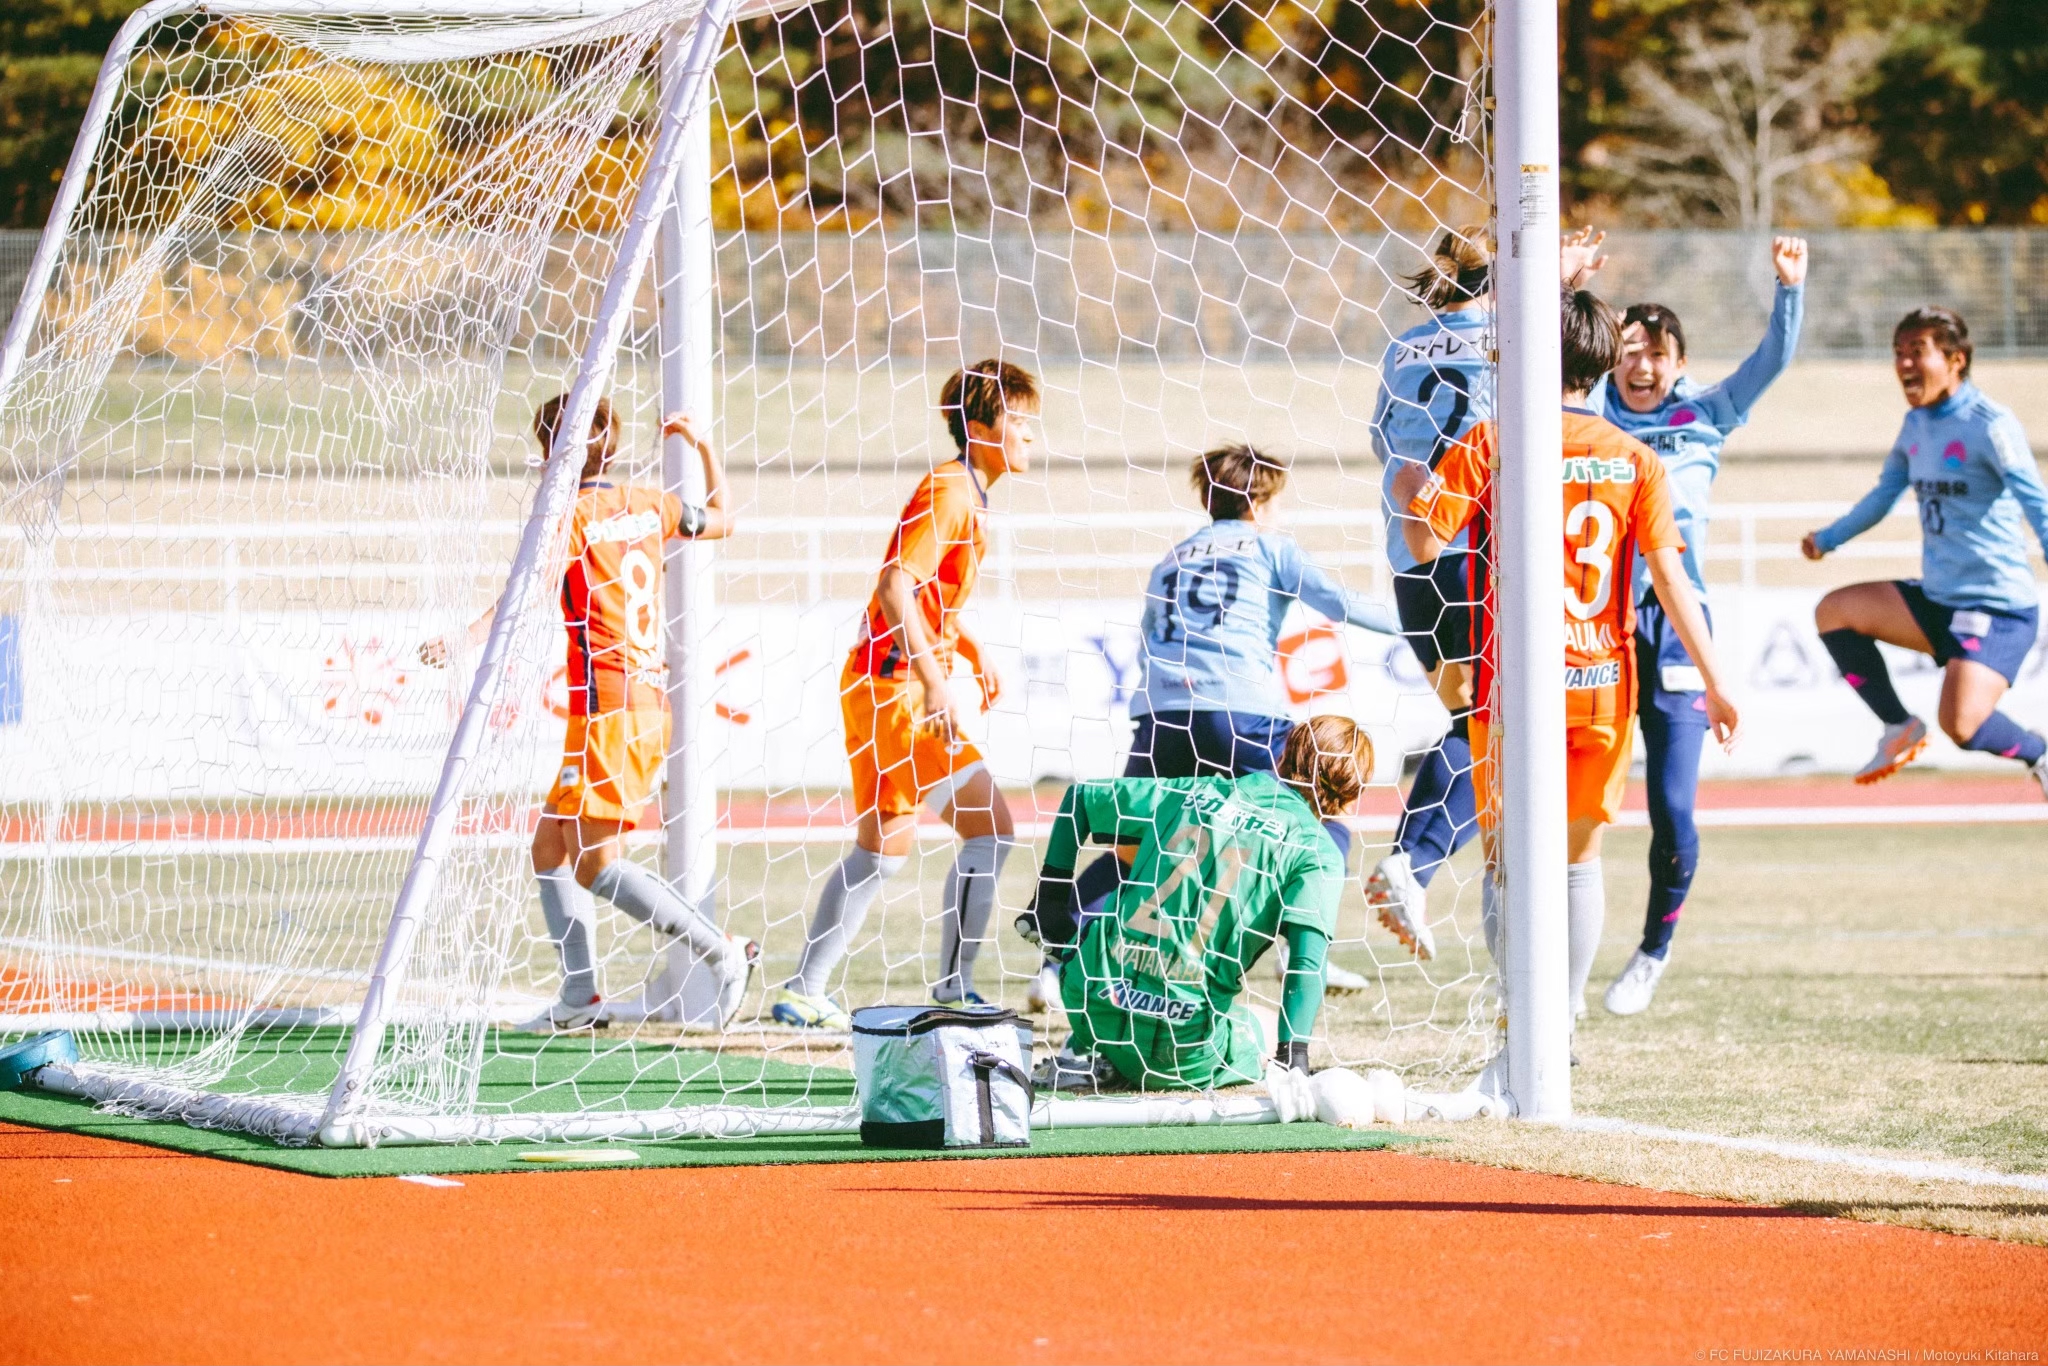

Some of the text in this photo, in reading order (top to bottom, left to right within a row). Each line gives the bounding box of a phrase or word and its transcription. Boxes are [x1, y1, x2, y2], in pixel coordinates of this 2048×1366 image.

[620, 549, 657, 650] 8
[1162, 562, 1239, 642] 19
[1124, 825, 1251, 955] 21
